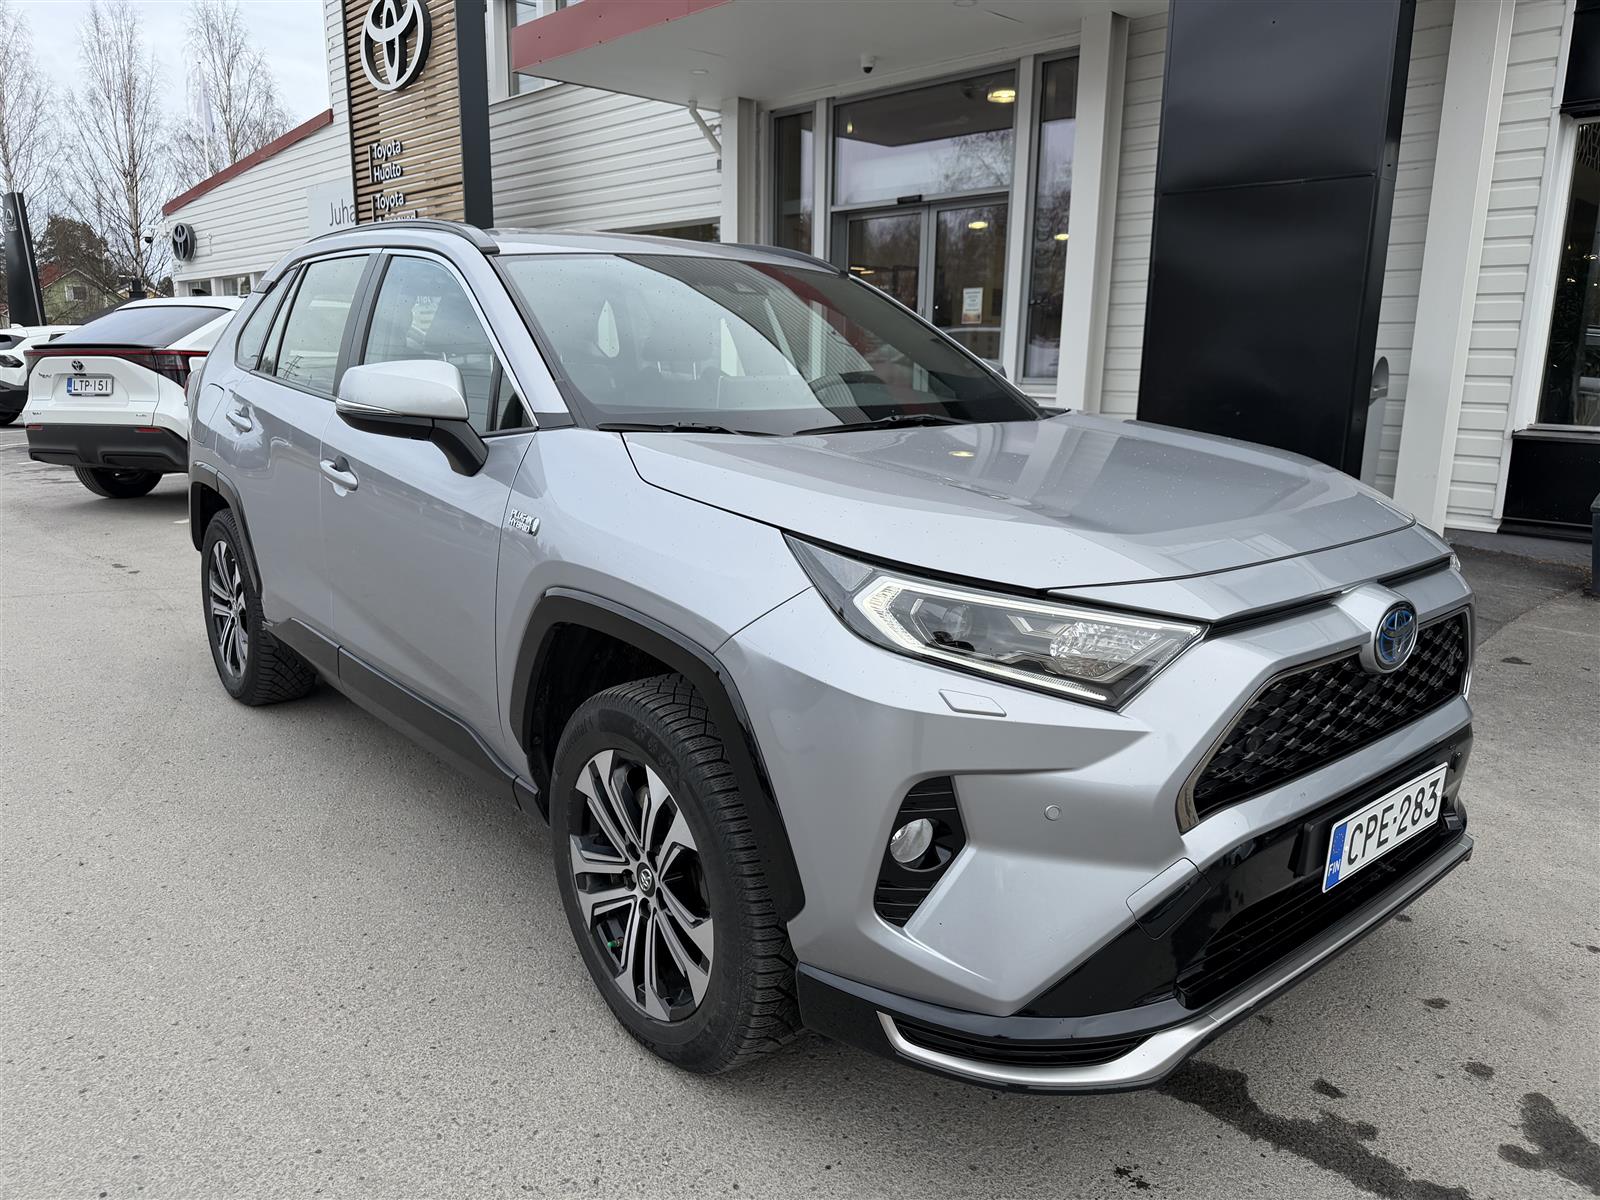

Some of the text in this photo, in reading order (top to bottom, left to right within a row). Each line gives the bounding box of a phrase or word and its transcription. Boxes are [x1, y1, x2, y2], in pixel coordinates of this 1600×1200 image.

[373, 140, 401, 160] Toyota
[373, 163, 401, 181] Huolto
[375, 192, 404, 211] Toyota
[329, 198, 356, 226] Juha
[73, 380, 108, 391] LTP-151
[1347, 777, 1441, 865] CPE-283
[1328, 859, 1341, 876] FIN
